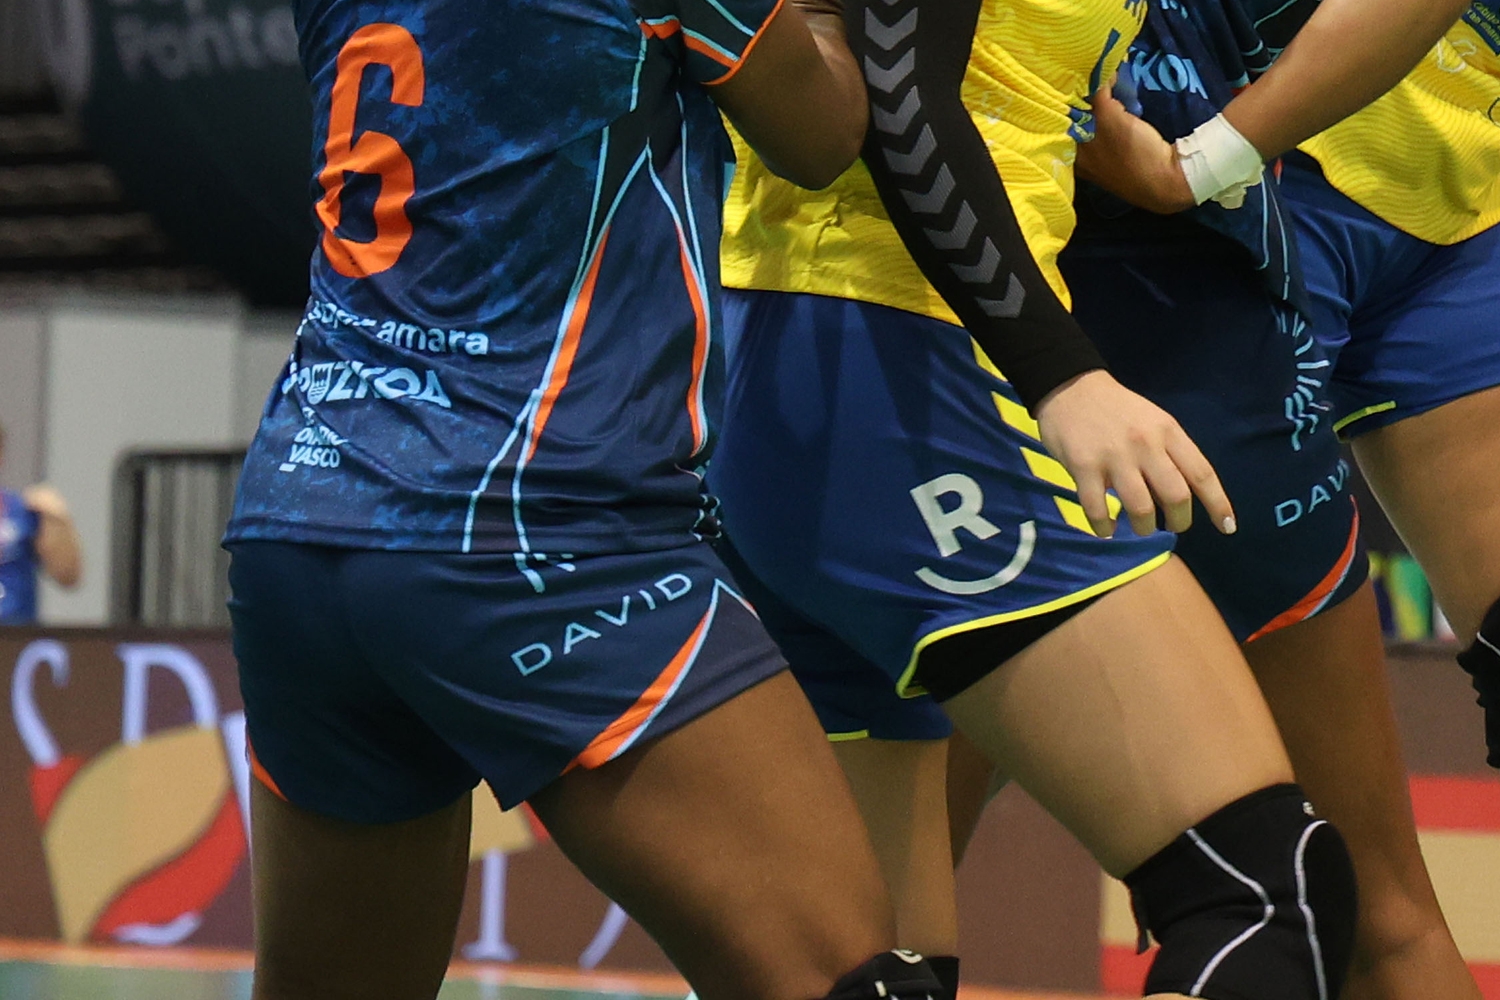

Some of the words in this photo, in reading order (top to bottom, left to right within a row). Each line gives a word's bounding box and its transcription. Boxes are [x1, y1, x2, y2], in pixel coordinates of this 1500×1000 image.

[313, 22, 425, 278] 6
[376, 320, 489, 355] amara
[288, 445, 340, 468] VASCO
[510, 572, 692, 677] DAVID
